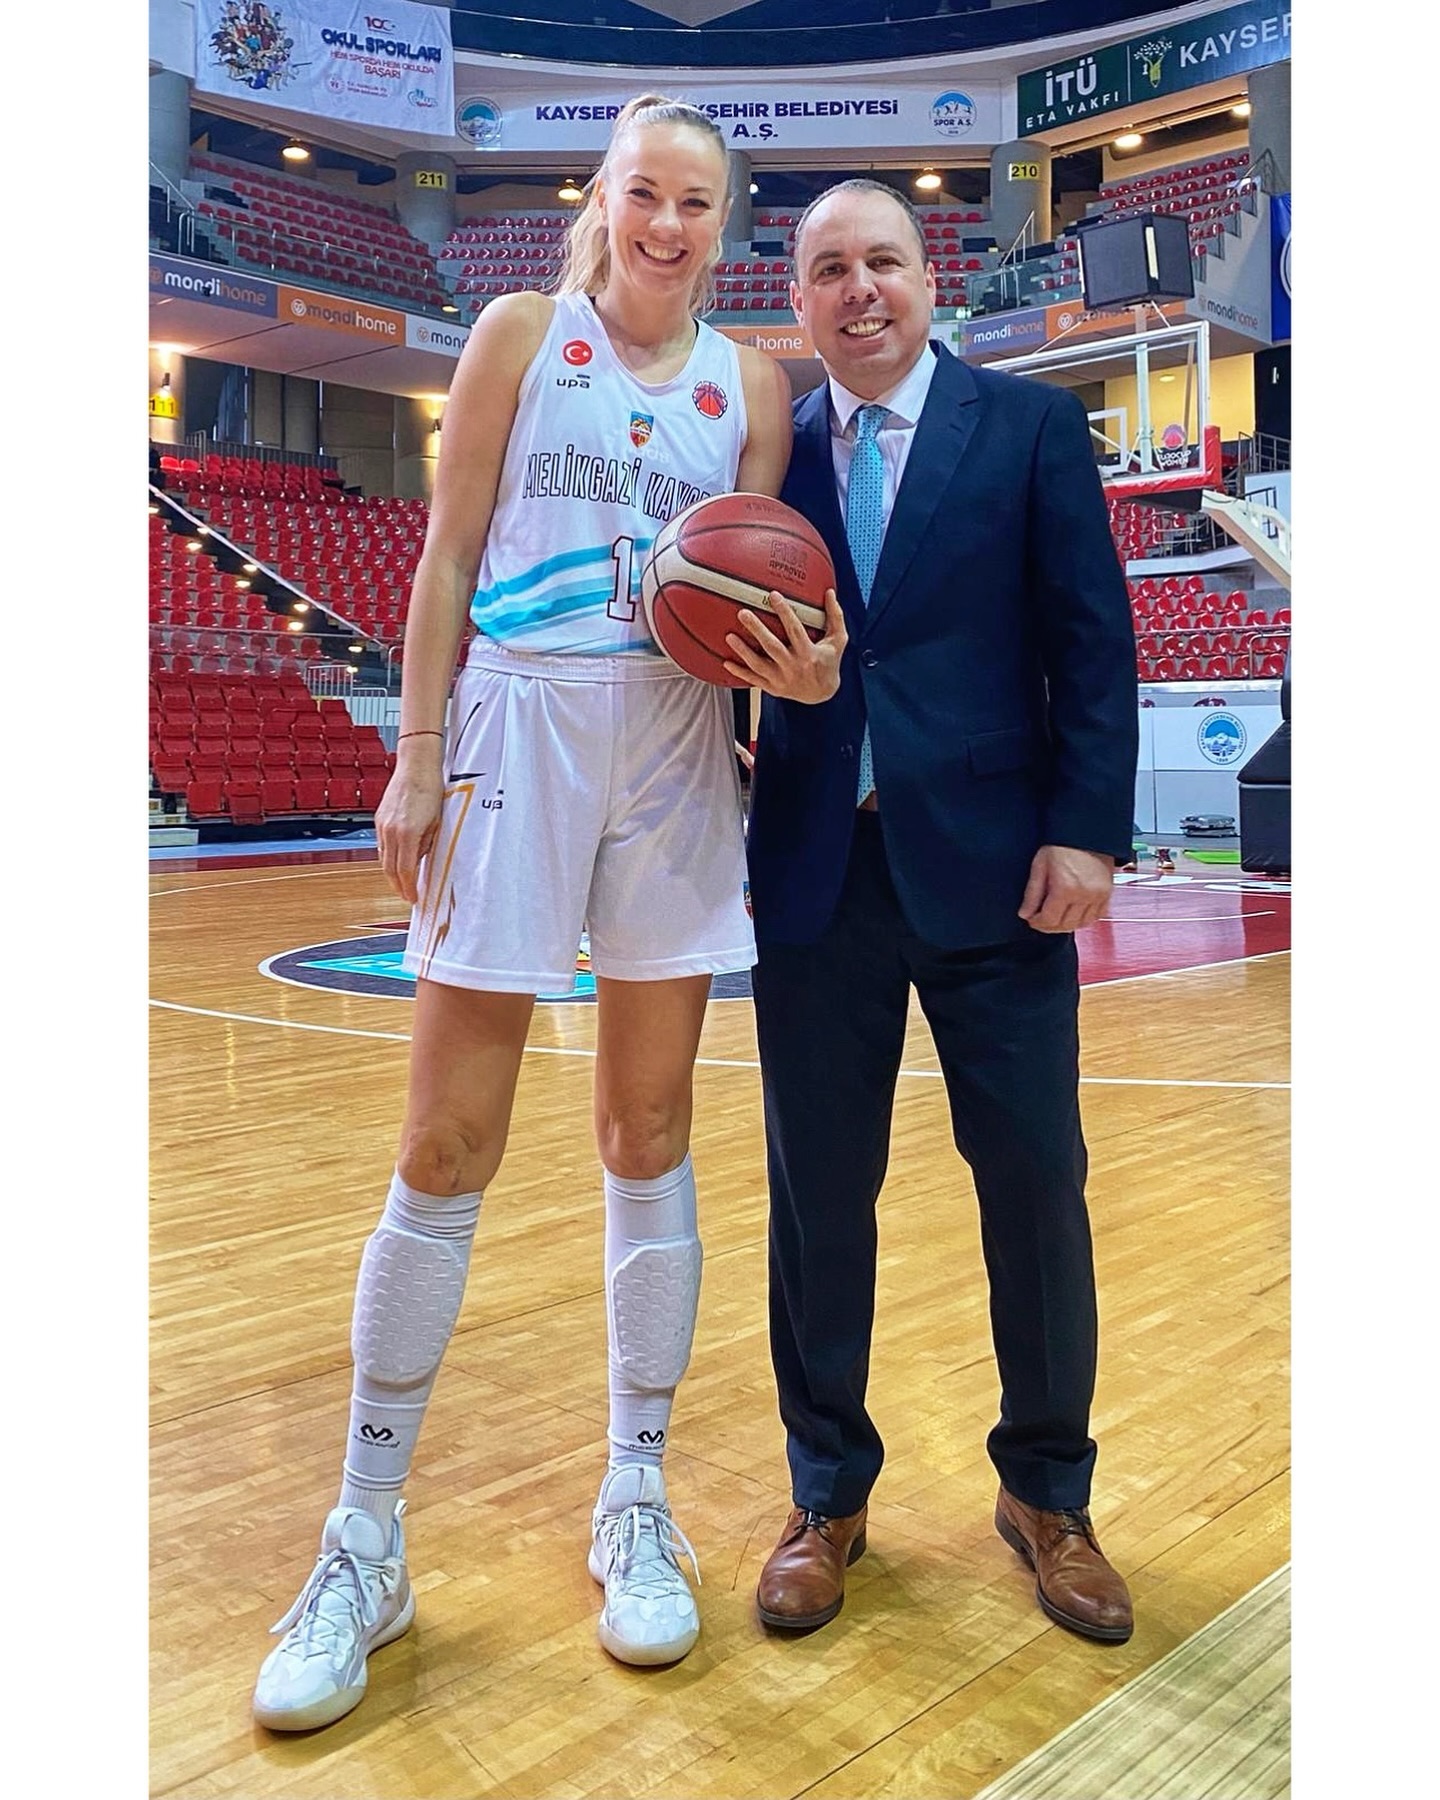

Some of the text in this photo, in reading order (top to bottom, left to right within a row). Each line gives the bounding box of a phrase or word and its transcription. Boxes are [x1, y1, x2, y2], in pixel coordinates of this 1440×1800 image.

[321, 28, 442, 63] OKUL SPORLARI
[364, 65, 401, 79] BAŞARI
[1046, 57, 1097, 107] İTÜ
[774, 99, 898, 119] BELEDİYESİ
[1026, 91, 1119, 128] ETA VAKFI
[934, 119, 955, 127] SPOR
[419, 172, 443, 186] 211
[1011, 165, 1038, 178] 210
[523, 443, 643, 508] MELİKGAZİ
[769, 560, 807, 580] APPROVED
